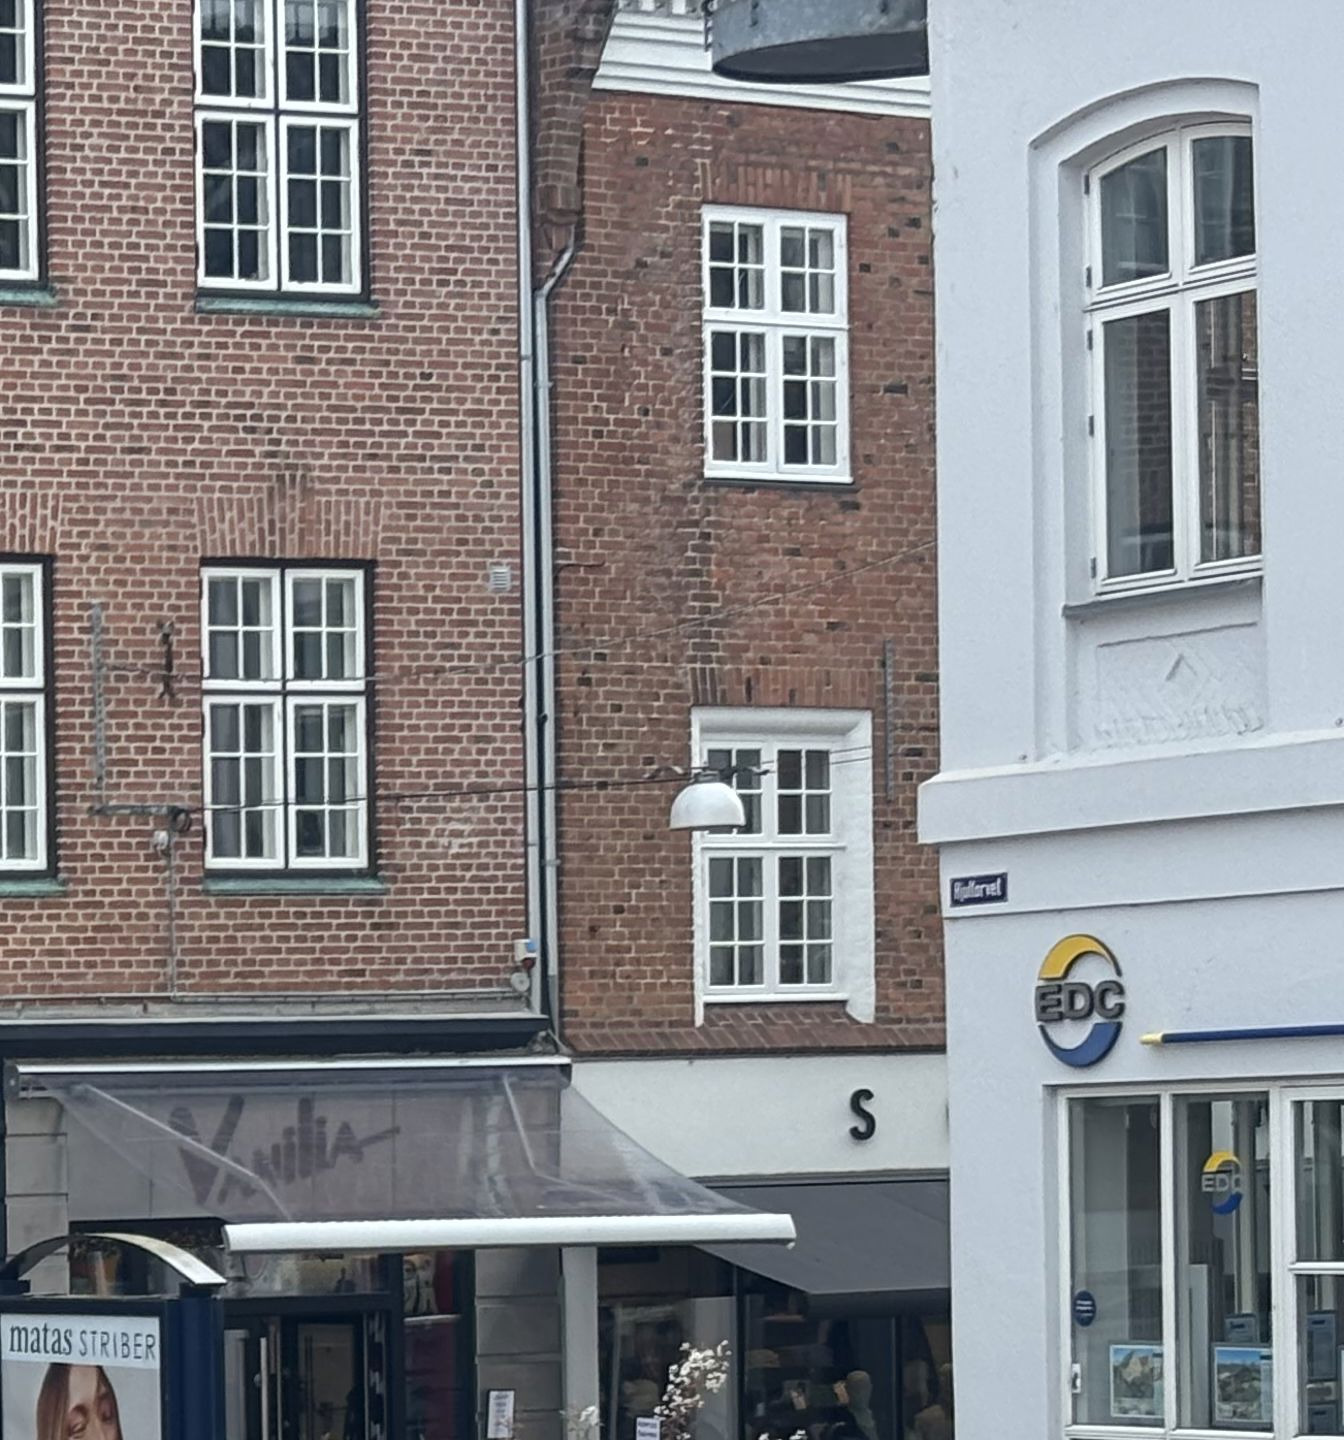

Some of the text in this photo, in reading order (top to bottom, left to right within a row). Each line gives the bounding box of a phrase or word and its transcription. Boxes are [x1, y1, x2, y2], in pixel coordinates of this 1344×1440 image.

[1034, 980, 1125, 1022] EDC
[9, 1322, 156, 1361] matas STRIBER
